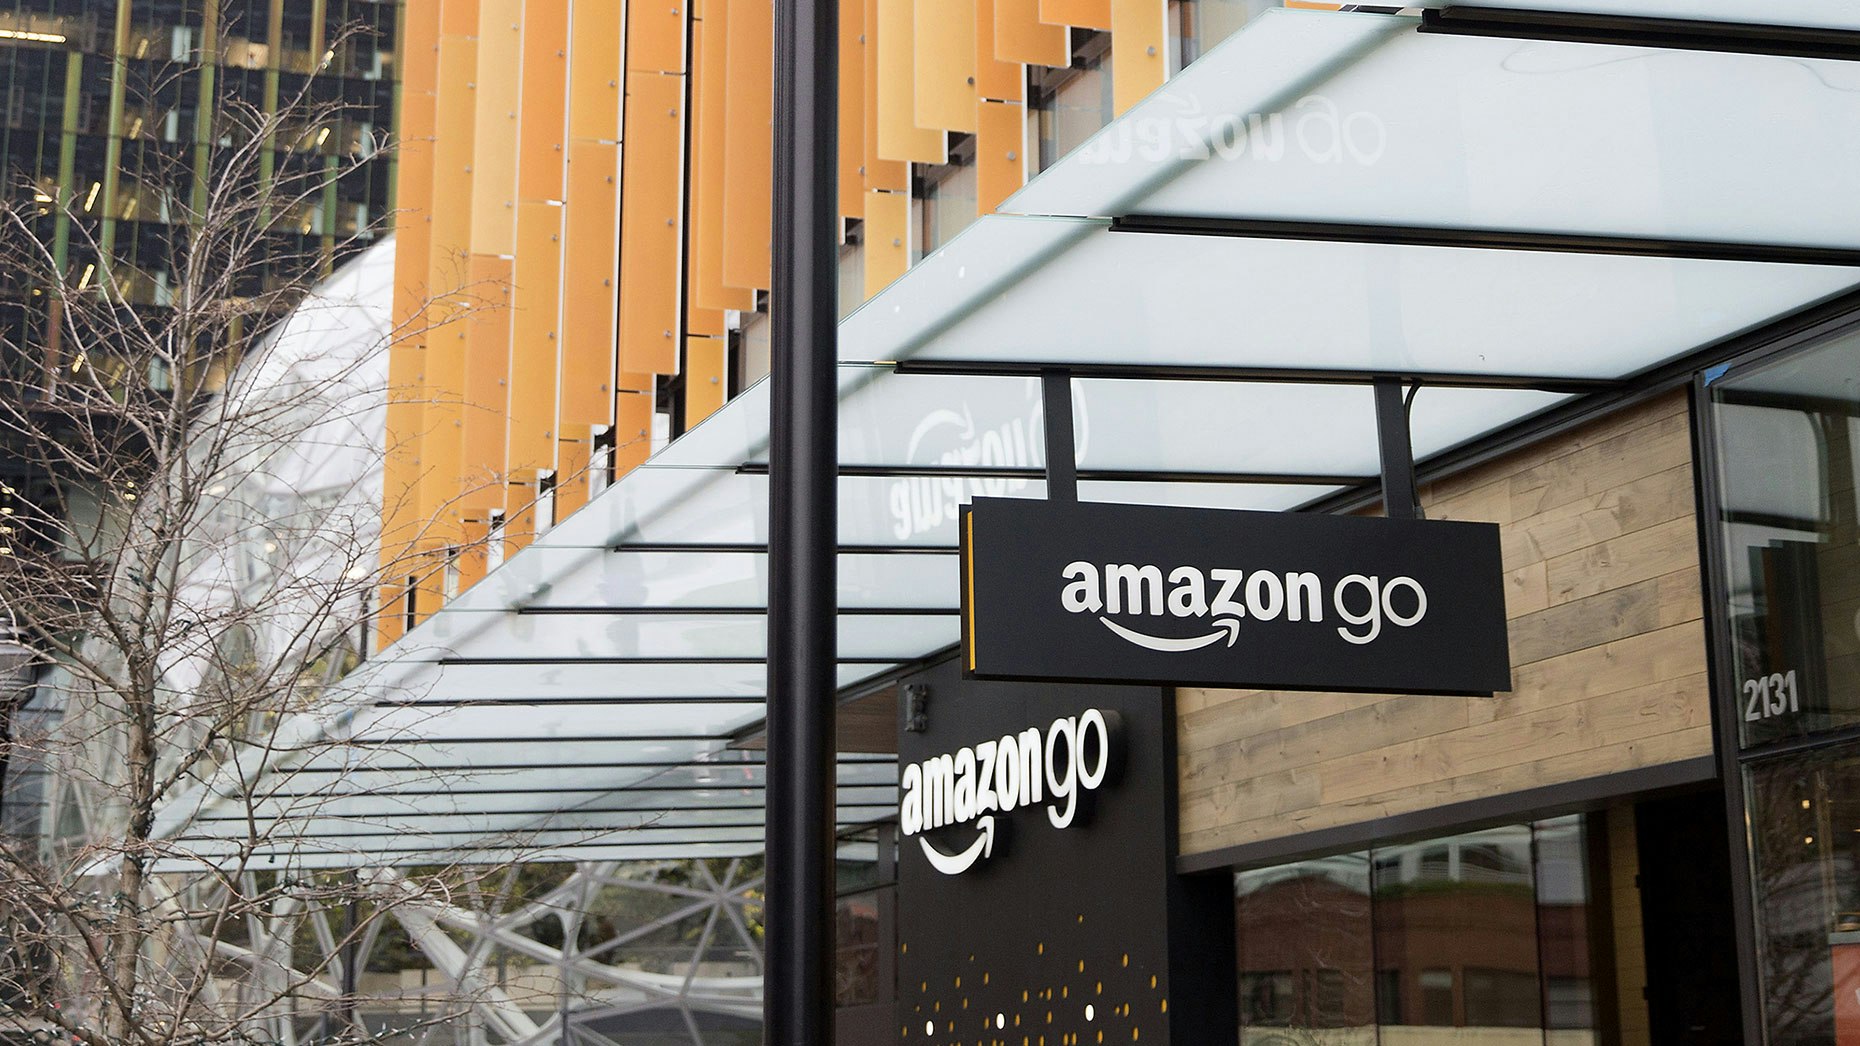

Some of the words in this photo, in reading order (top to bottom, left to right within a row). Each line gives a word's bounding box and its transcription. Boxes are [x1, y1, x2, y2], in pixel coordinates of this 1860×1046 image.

[1061, 561, 1324, 623] amazon
[1333, 574, 1428, 645] go
[1743, 670, 1799, 722] 2131
[901, 727, 1043, 836] amazon
[1045, 708, 1109, 819] go
